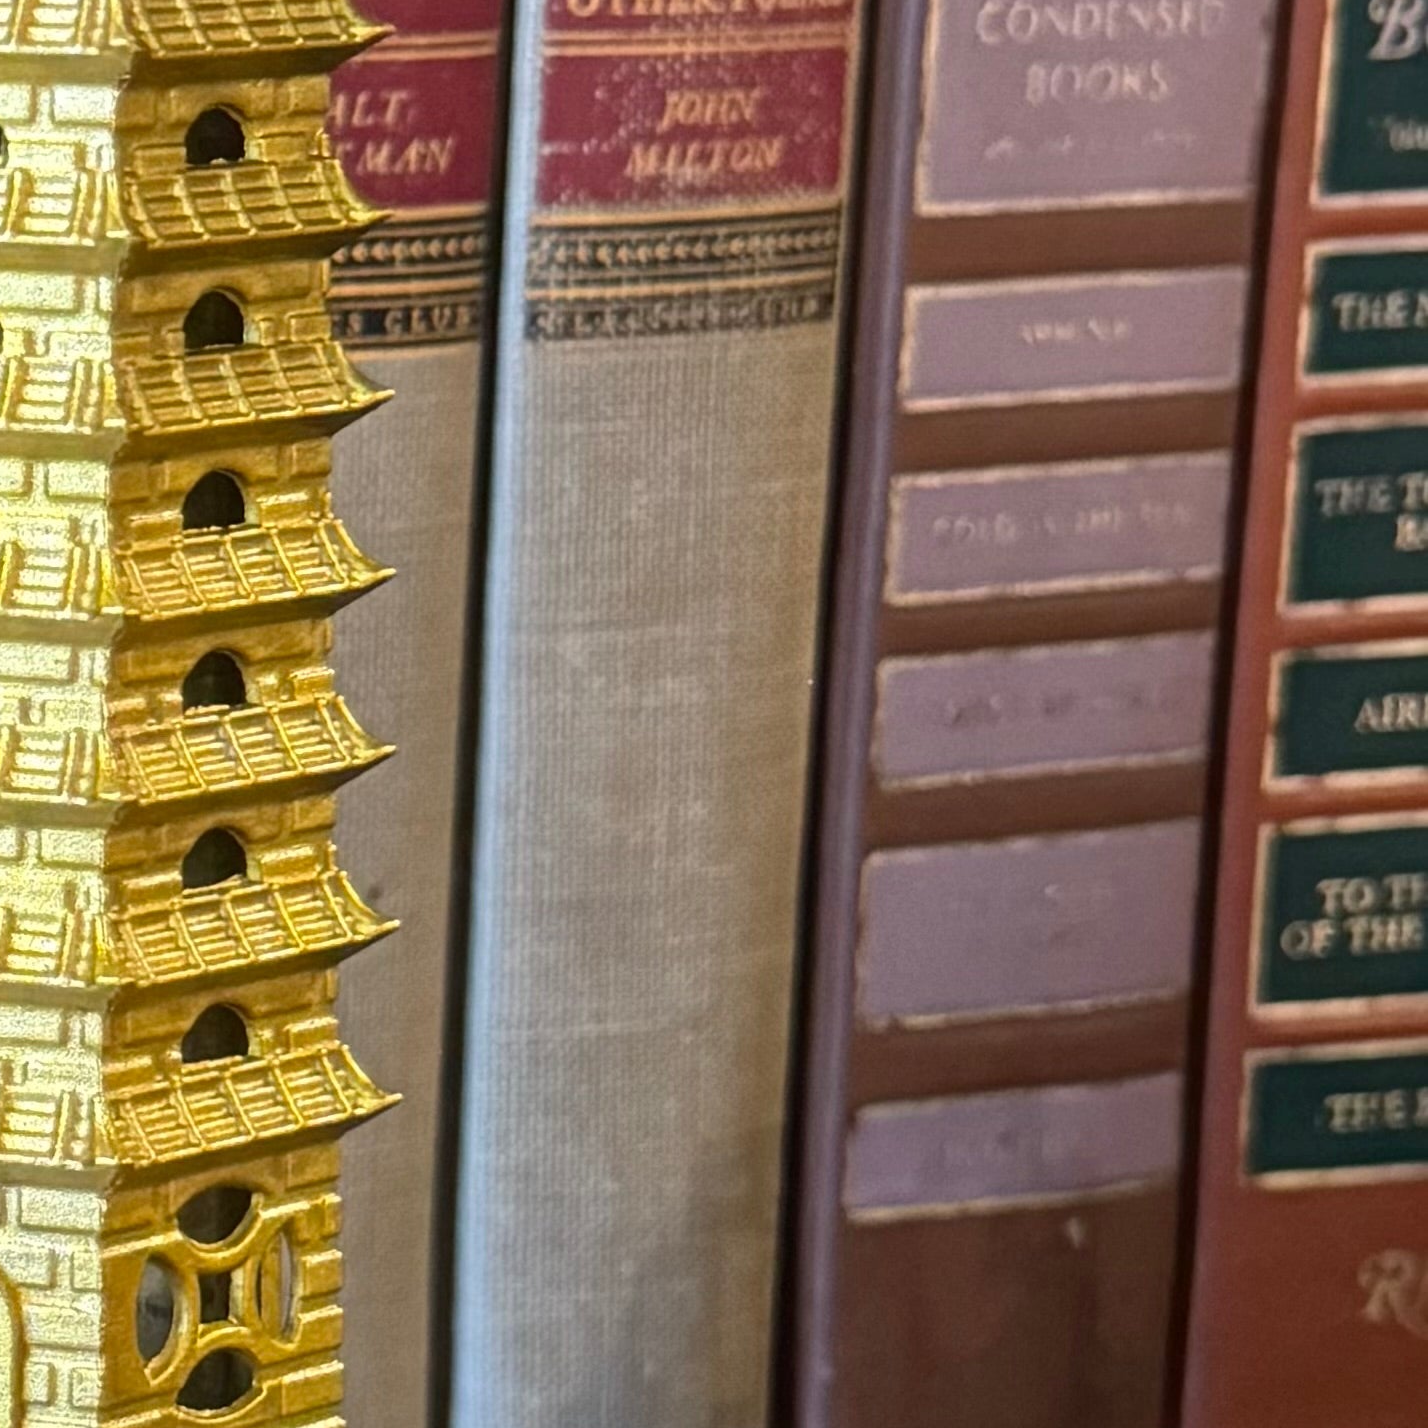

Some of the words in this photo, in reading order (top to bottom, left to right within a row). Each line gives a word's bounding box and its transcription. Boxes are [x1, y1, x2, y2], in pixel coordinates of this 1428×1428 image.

[656, 87, 763, 134] JOHN
[624, 135, 784, 181] MILTON
[1331, 290, 1407, 332] THE
[1315, 475, 1392, 517] THE
[1317, 877, 1376, 917] TO
[1280, 919, 1334, 961] OF
[1344, 914, 1426, 956] THE
